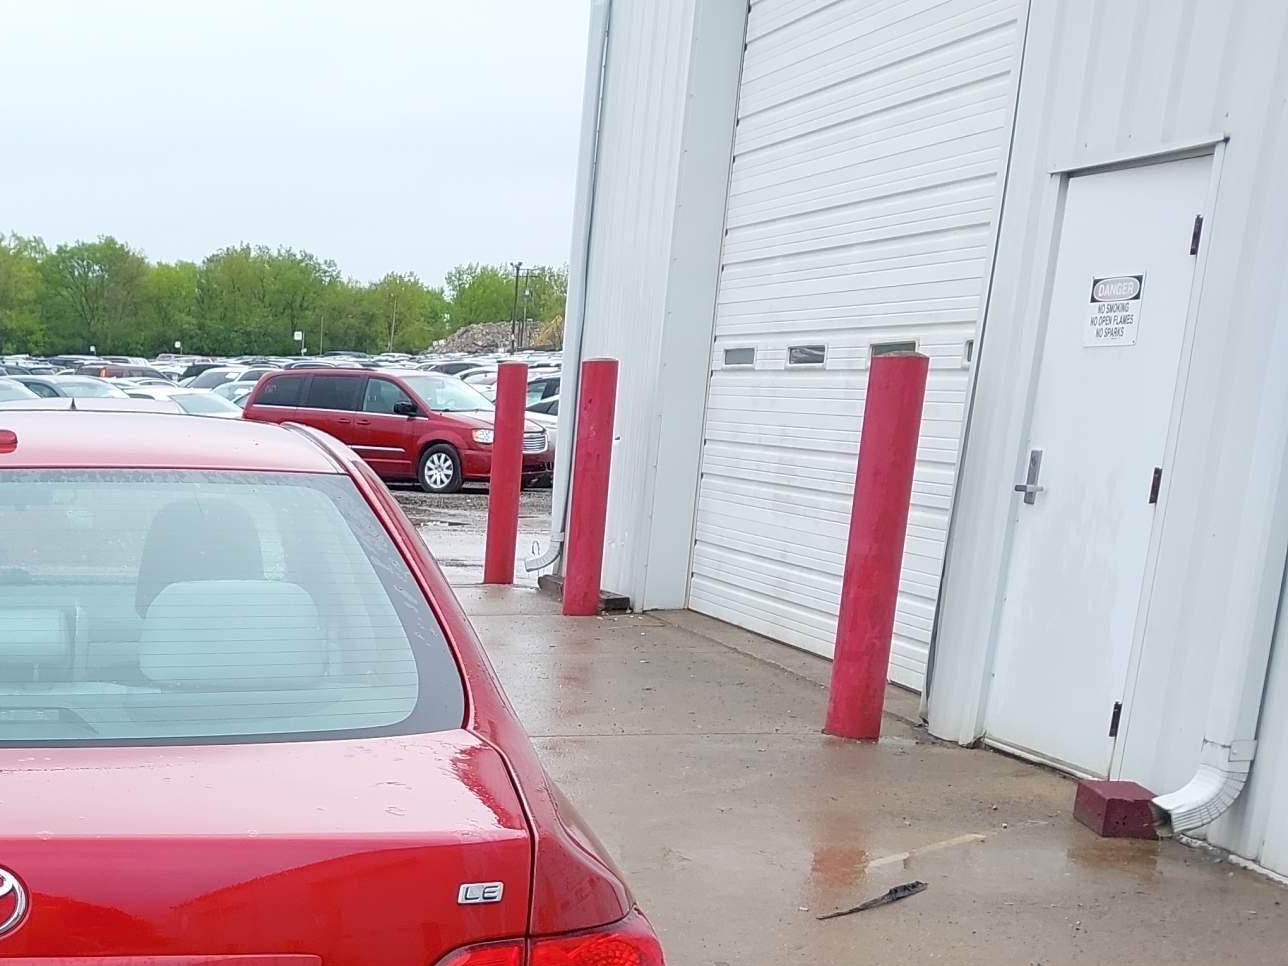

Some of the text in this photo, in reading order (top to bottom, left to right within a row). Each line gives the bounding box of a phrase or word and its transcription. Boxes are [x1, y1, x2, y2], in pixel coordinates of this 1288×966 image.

[1099, 282, 1134, 297] DANGER
[1098, 302, 1130, 314] NO SMOKING
[1090, 314, 1134, 327] NO OPEN FLAMES
[1096, 326, 1124, 338] NO SPARKS
[464, 885, 499, 900] LE
